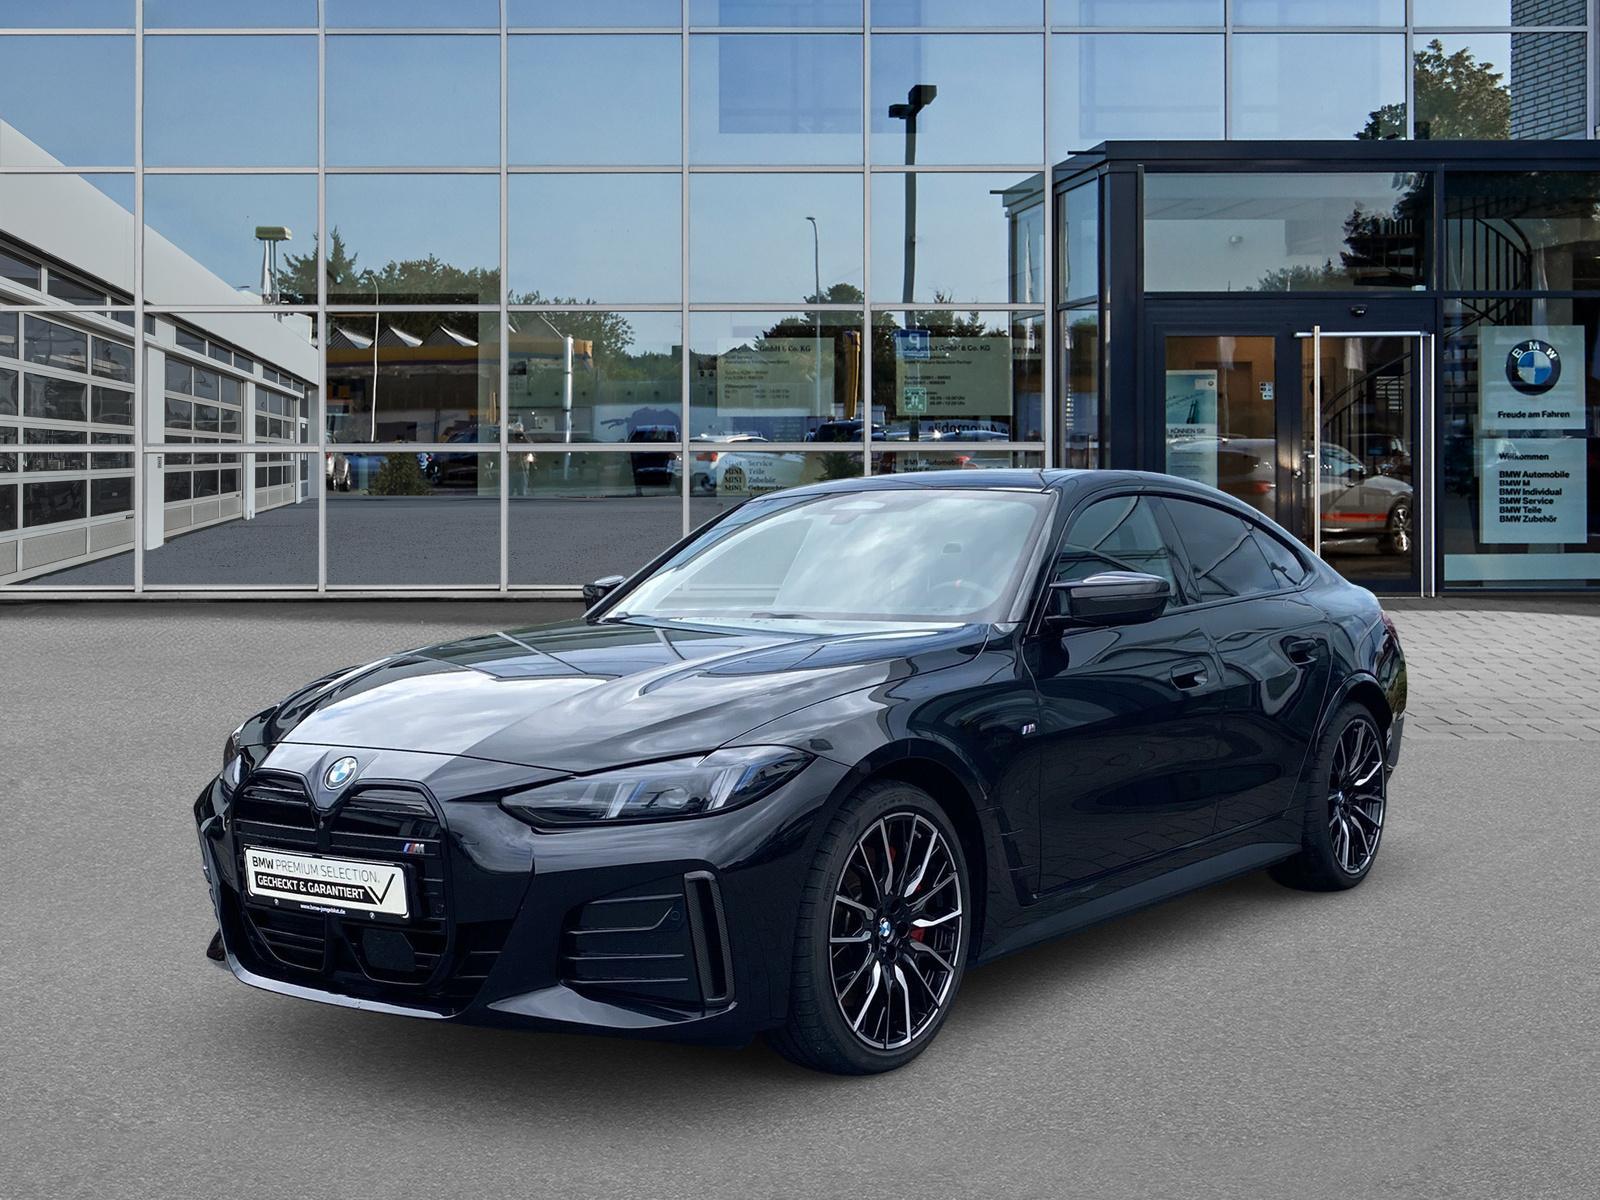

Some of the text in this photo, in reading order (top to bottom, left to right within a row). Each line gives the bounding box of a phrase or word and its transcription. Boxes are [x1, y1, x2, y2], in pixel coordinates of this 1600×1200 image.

[800, 344, 811, 352] KG
[980, 344, 991, 352] KG
[1511, 341, 1558, 360] BMW
[724, 475, 742, 483] MINI
[1499, 515, 1557, 523] BMW Zubehör
[252, 856, 274, 870] BMW
[275, 859, 319, 876] PREMIUM
[257, 874, 365, 899] GECHECKT & GARANTIERT
